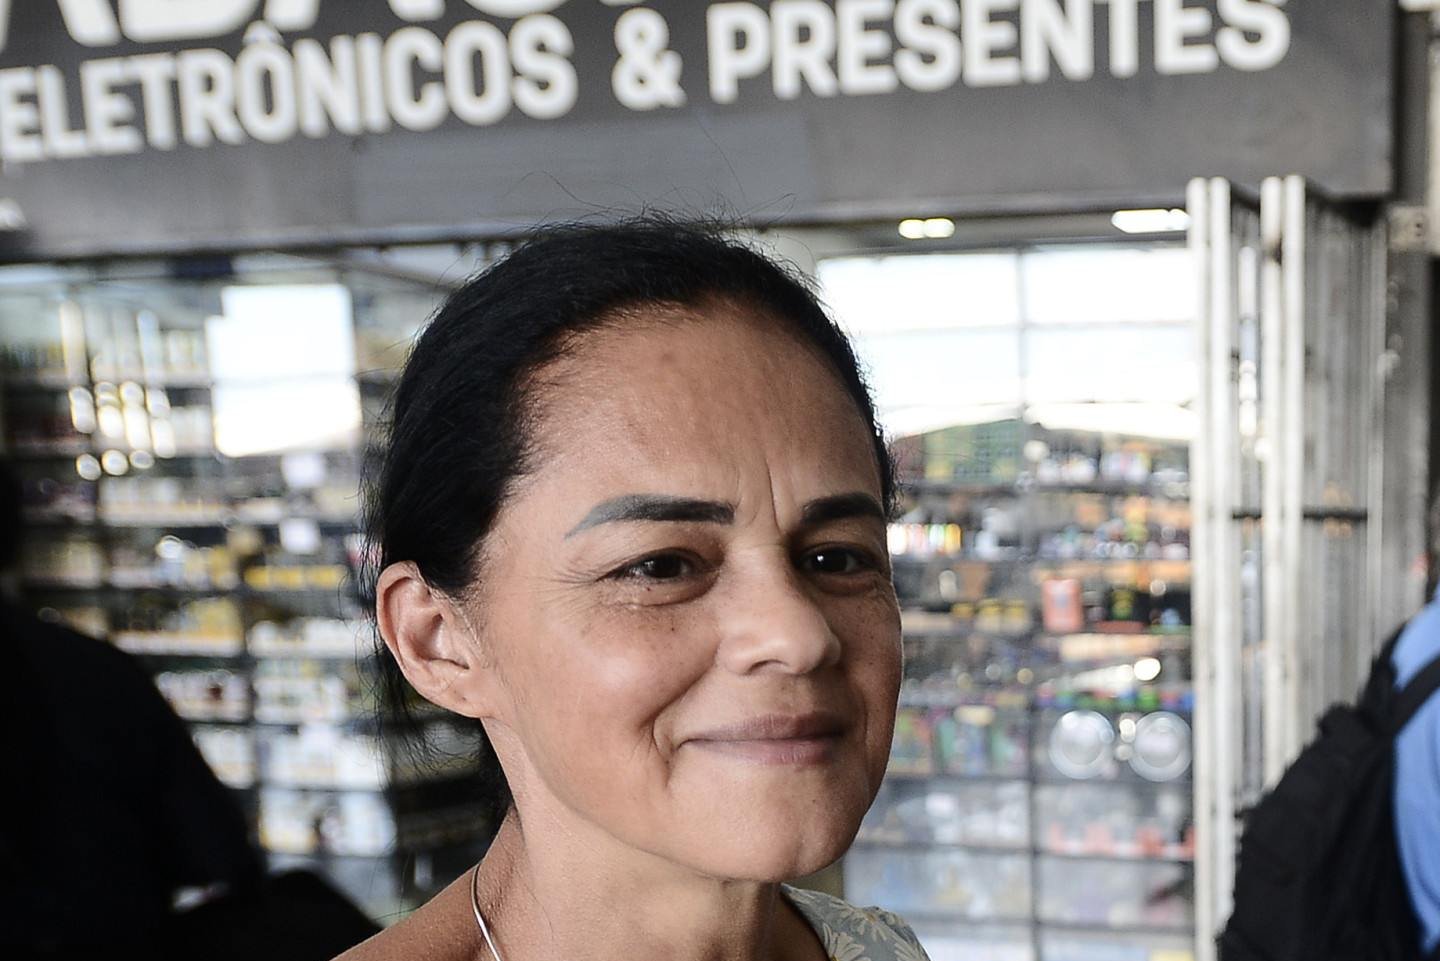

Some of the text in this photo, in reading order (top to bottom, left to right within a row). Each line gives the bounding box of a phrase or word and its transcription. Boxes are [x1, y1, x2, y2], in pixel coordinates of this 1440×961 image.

[0, 0, 1291, 163] ELETRÔNICOS & PRESENTES
